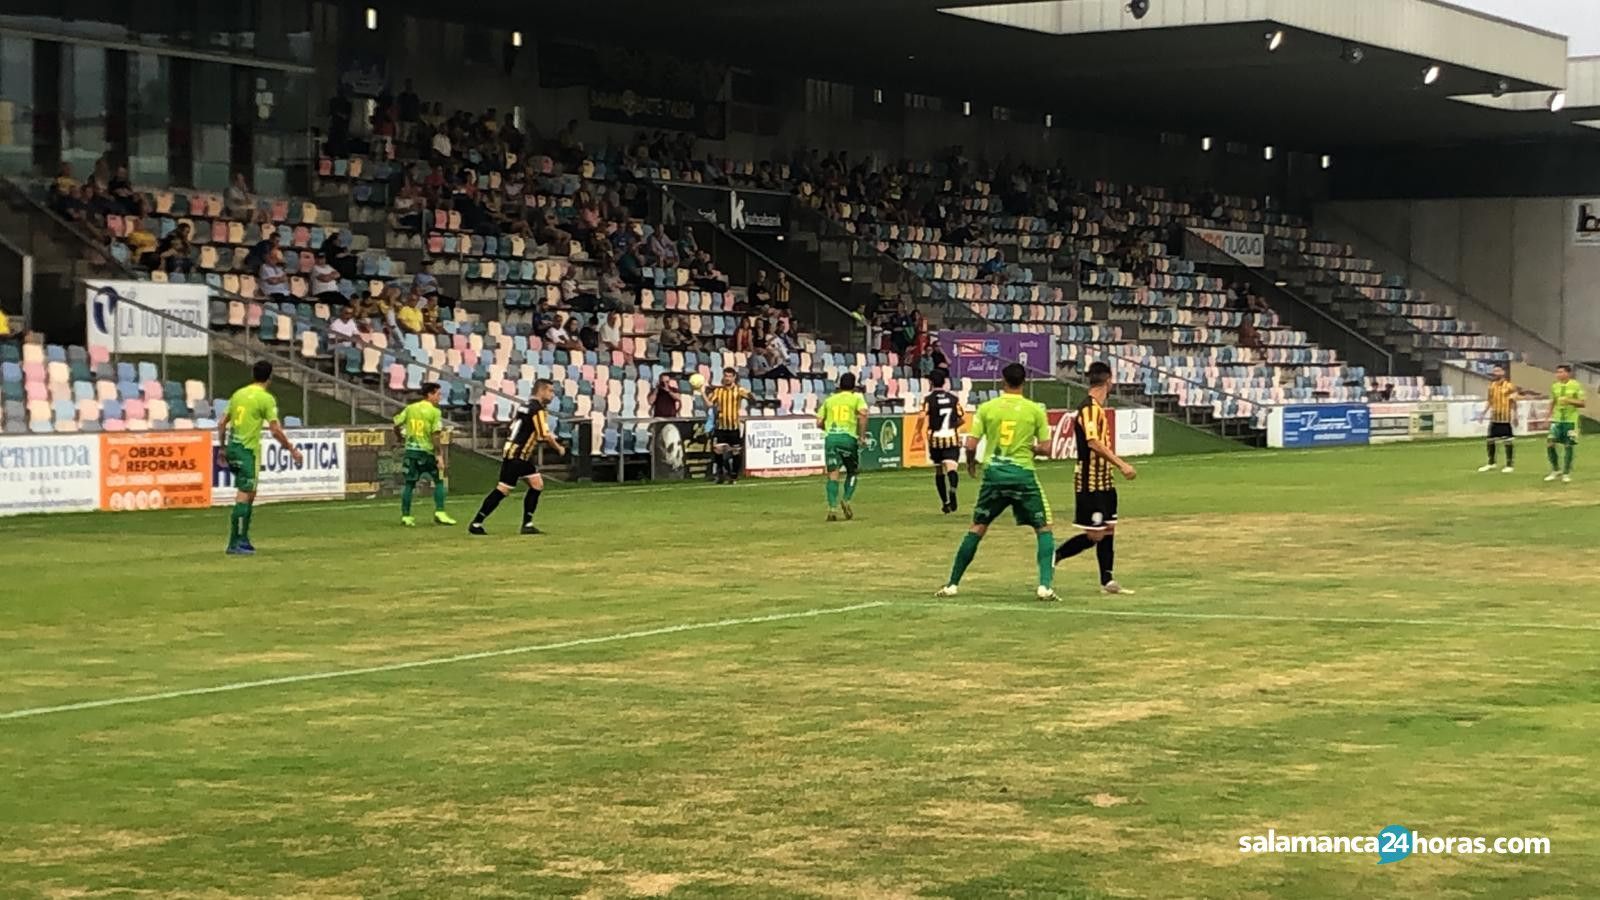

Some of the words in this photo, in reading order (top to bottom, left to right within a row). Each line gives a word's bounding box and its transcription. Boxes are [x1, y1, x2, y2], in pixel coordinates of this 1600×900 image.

[831, 404, 849, 422] 16
[939, 408, 953, 435] 7
[1000, 420, 1017, 446] 5
[129, 447, 173, 458] OBRAS
[178, 446, 187, 457] Y
[748, 433, 793, 453] Margarita
[127, 459, 196, 472] REFORMAS
[773, 449, 806, 465] Esteban
